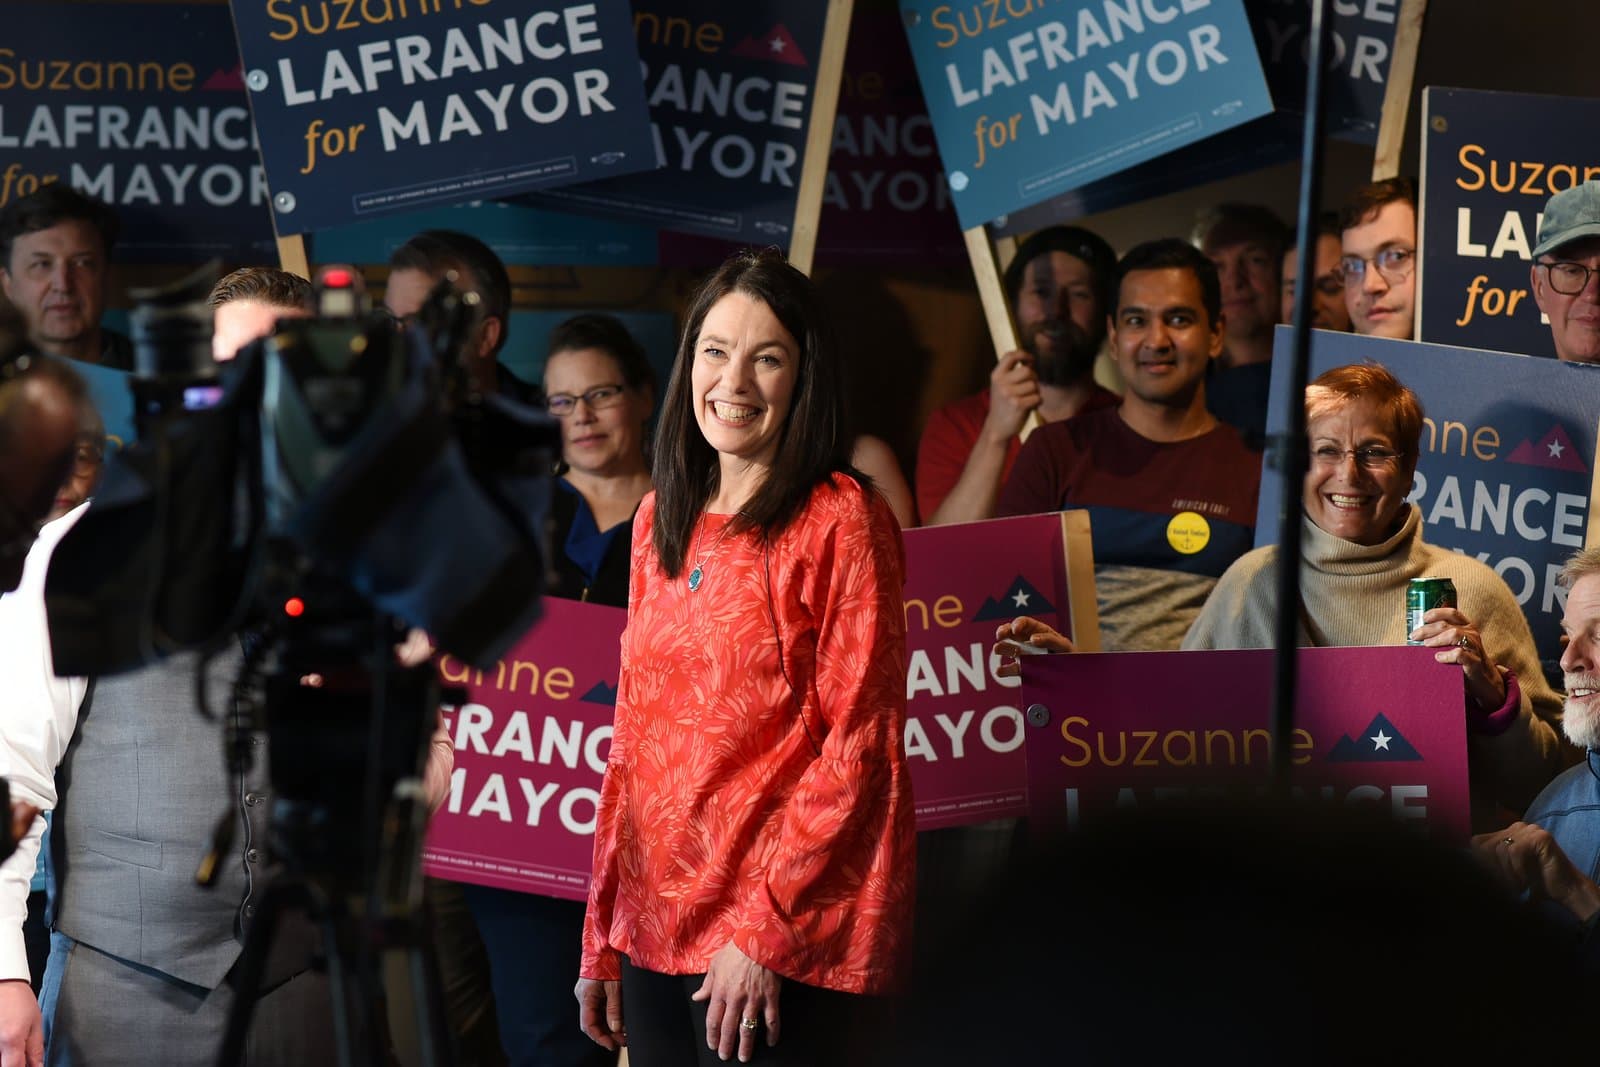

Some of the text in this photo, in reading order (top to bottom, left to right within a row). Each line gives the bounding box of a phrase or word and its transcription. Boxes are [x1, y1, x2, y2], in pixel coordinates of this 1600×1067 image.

[277, 3, 603, 106] LAFRANCE
[640, 64, 807, 129] ANCE
[945, 0, 1212, 108] LAFRANC
[974, 115, 1024, 169] for
[1029, 24, 1229, 136] MAYOR
[0, 104, 260, 150] LAFRANC
[301, 69, 616, 174] for MAYOR
[1456, 275, 1528, 327] for
